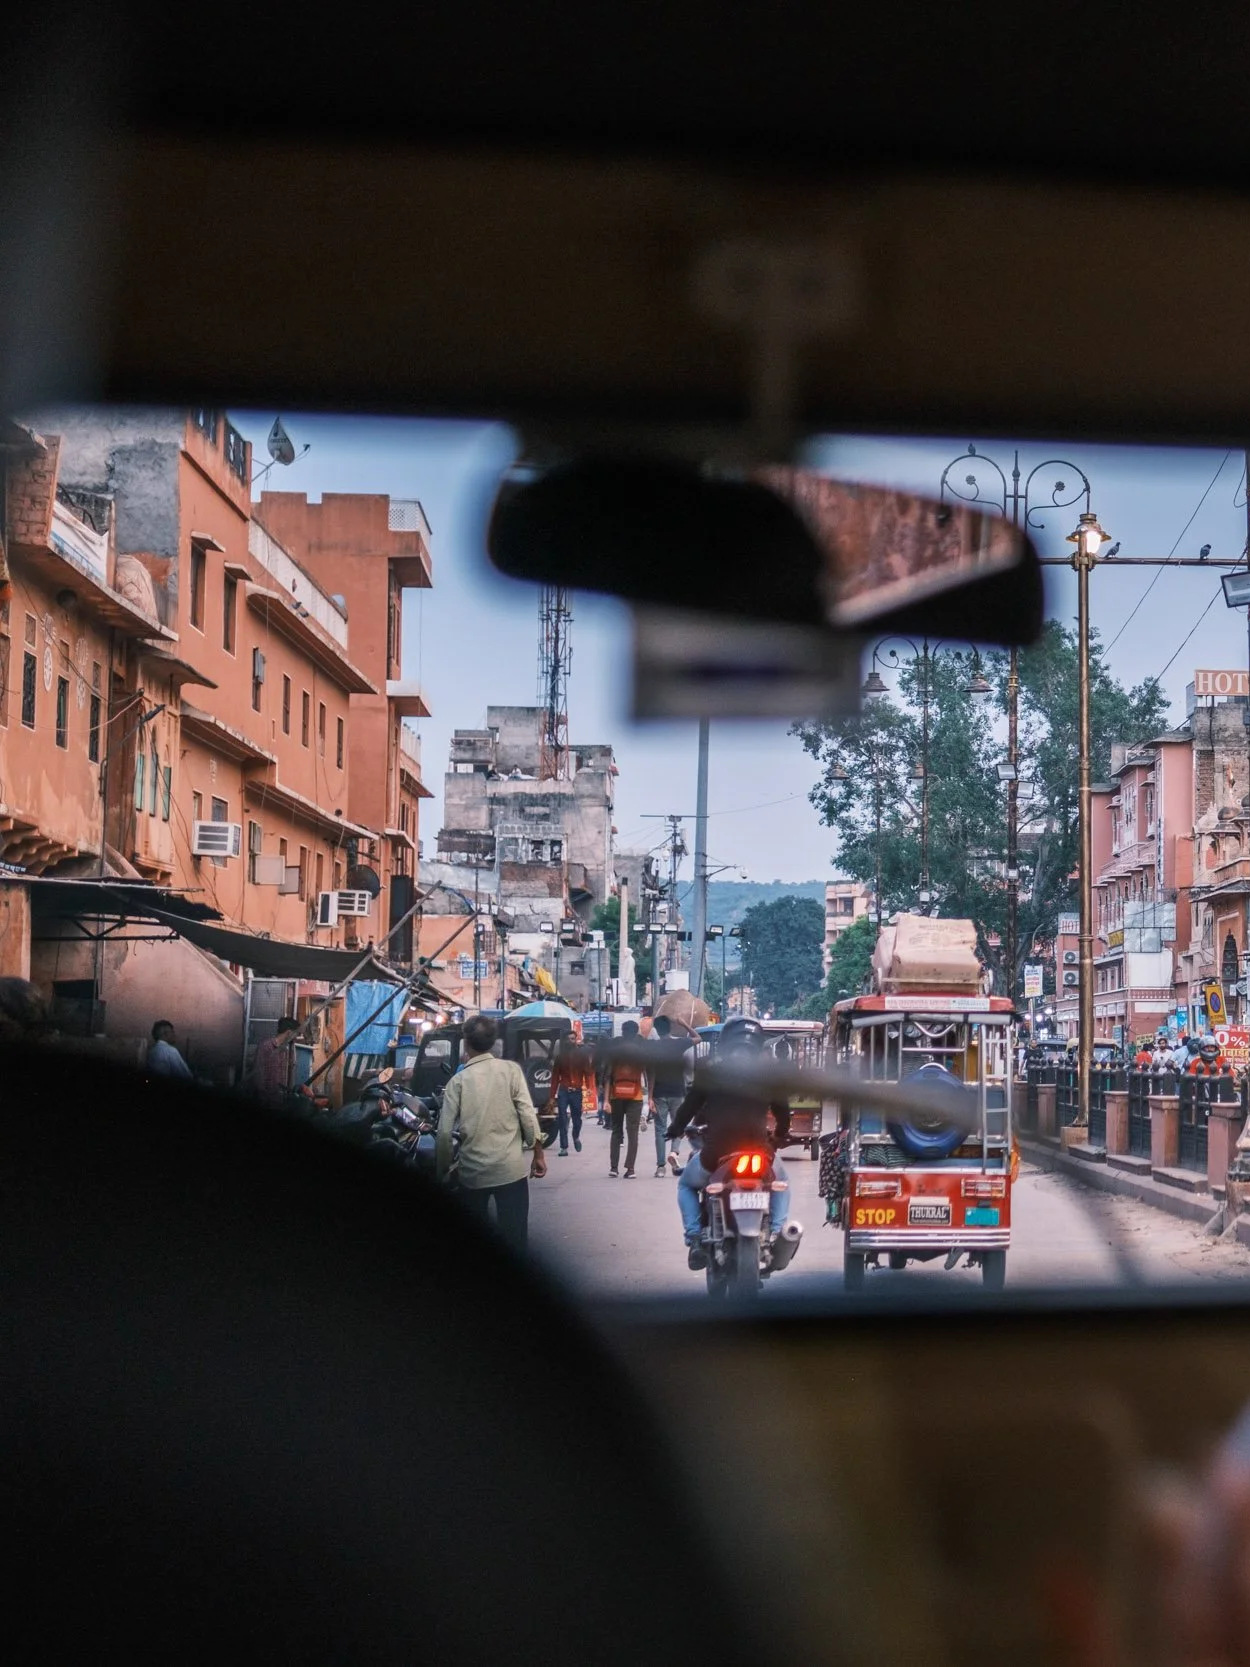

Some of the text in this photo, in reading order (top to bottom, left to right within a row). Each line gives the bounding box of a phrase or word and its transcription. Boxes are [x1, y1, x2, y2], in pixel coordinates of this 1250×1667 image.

[1061, 921, 1081, 933] HOT
[856, 1208, 896, 1225] STOP
[910, 1206, 947, 1219] THUKRAL
